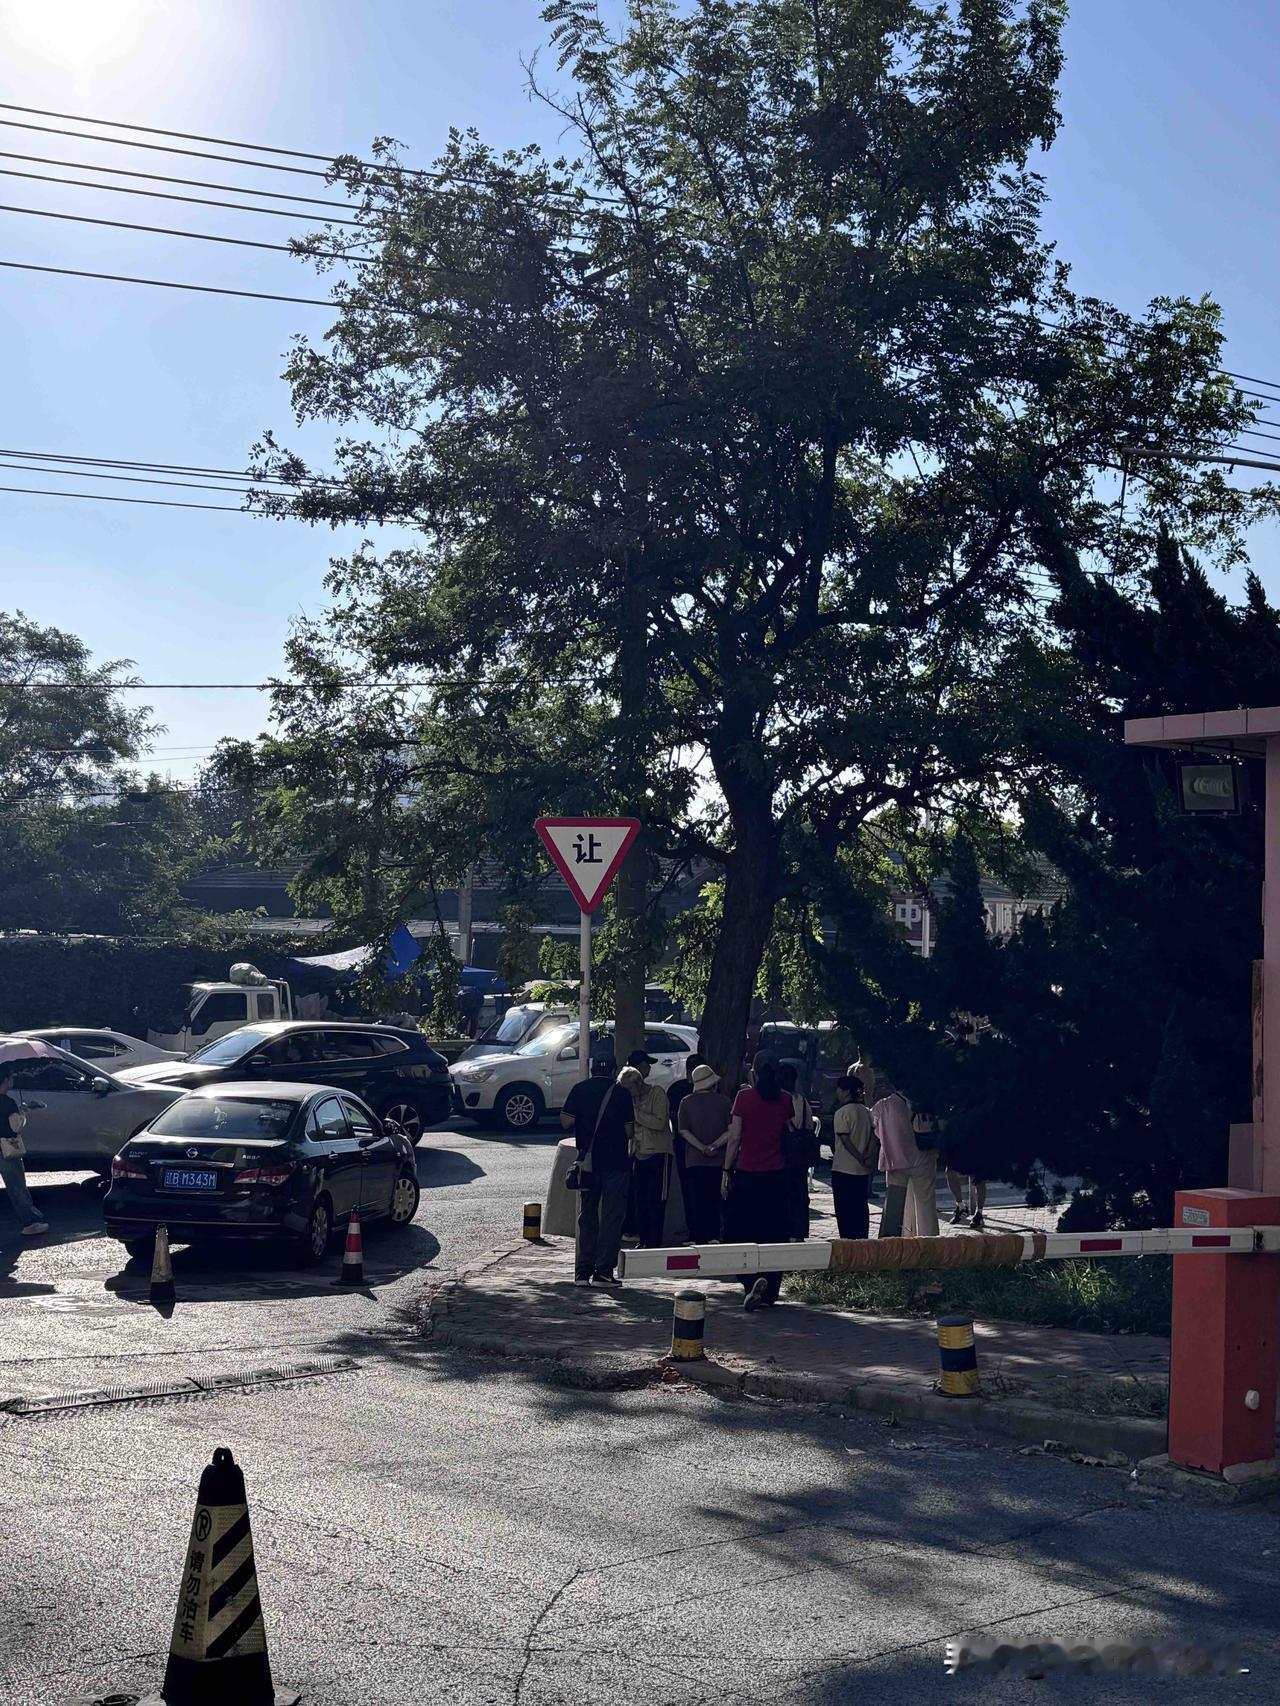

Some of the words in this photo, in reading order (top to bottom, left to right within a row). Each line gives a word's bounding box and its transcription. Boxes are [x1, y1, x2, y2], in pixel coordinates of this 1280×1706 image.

[572, 833, 603, 864] 让
[179, 1551, 206, 1644] 请勿泊车
